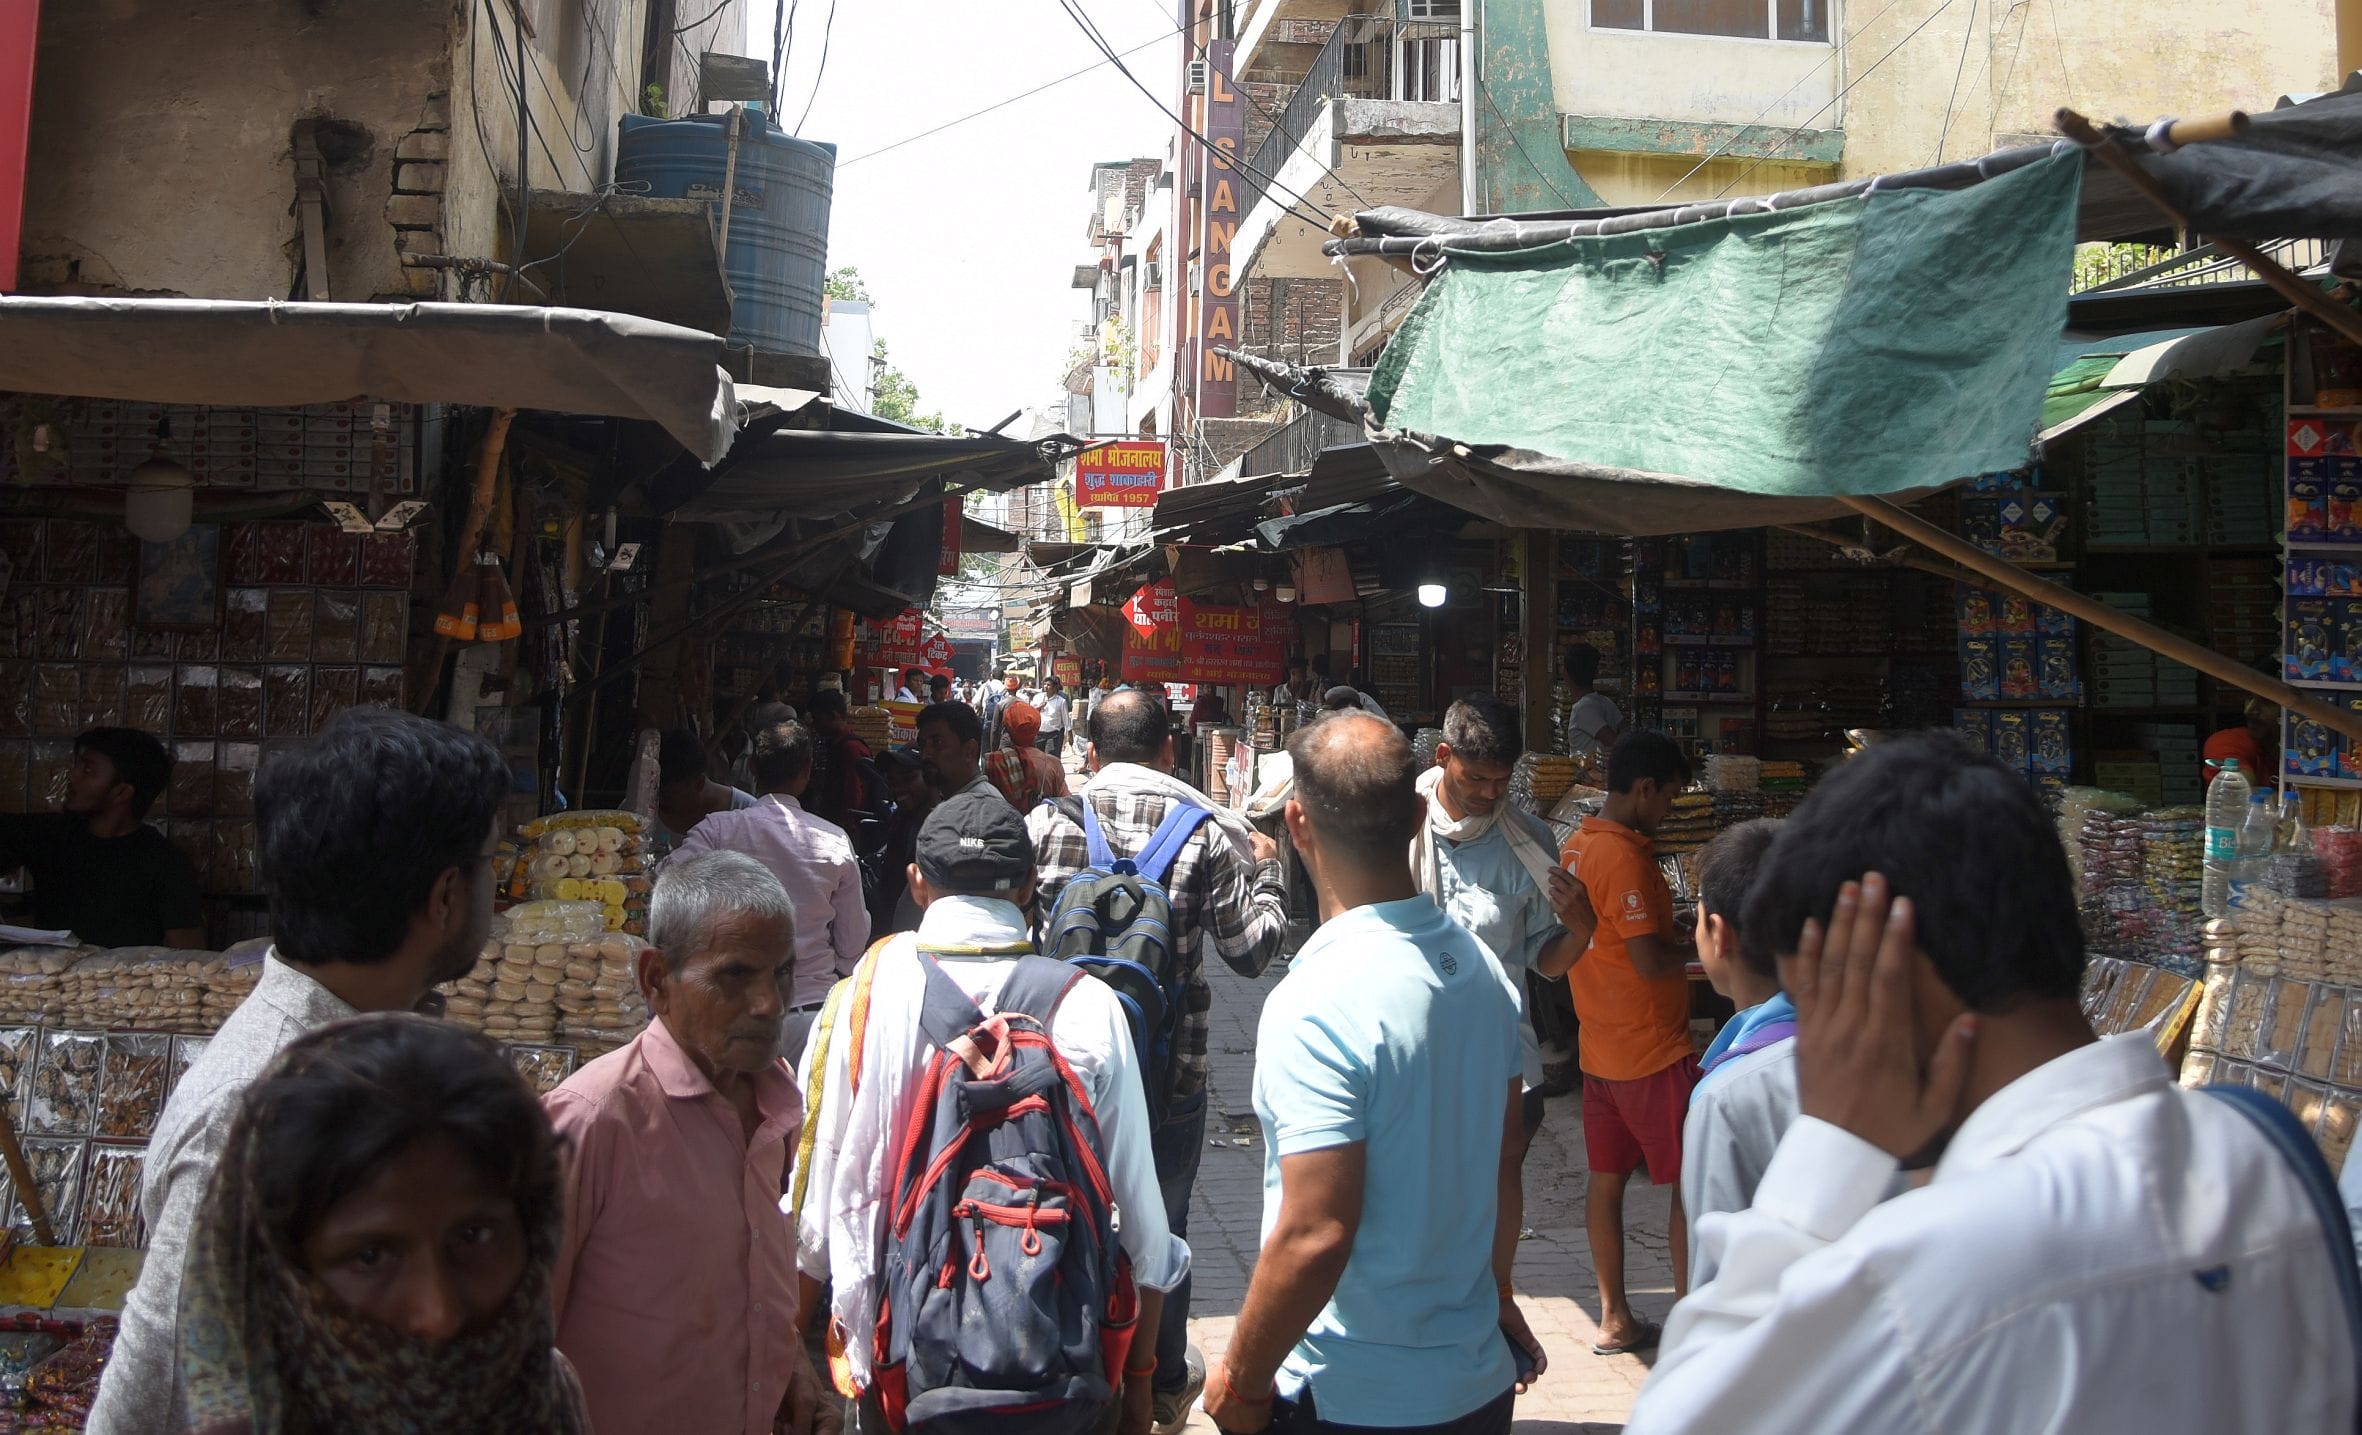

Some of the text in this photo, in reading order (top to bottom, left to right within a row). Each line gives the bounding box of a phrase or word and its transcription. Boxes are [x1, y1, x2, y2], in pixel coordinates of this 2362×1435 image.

[1205, 136, 1236, 382] SANGAM
[1107, 445, 1162, 468] भोजनालय
[1084, 471, 1156, 490] शुद्ध शाकाहारी
[1123, 494, 1149, 503] 1957
[1194, 608, 1240, 630] शर्मा
[934, 637, 945, 650] रेल
[927, 647, 948, 660] टिकट
[1056, 660, 1079, 671] थाली
[959, 837, 985, 849] NIKE
